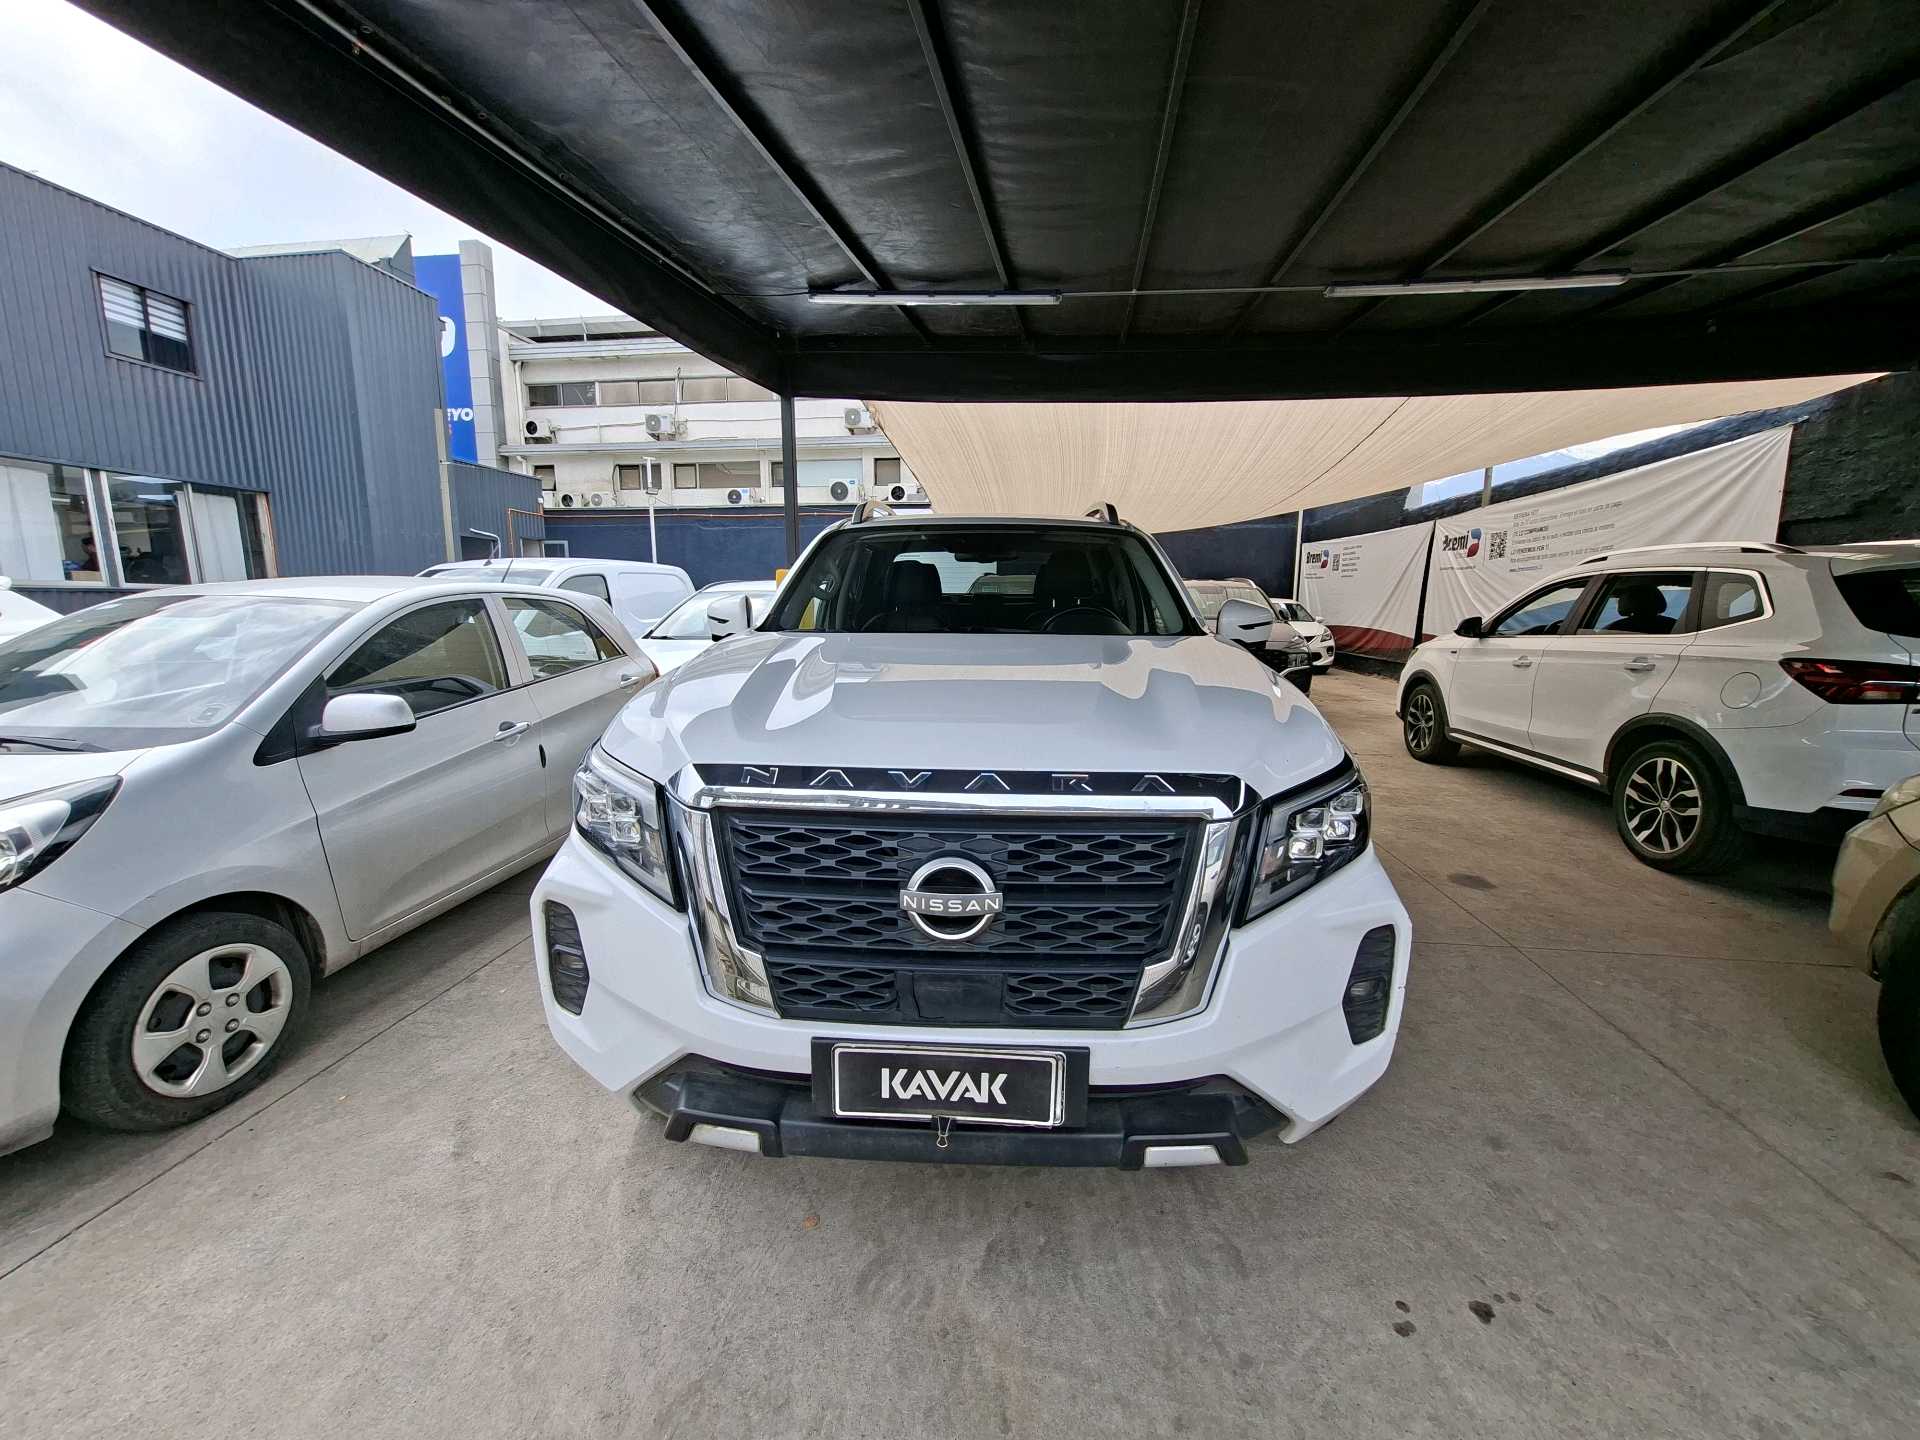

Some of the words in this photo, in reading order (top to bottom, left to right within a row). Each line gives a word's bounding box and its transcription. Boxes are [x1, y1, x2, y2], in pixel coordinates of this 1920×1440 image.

[742, 767, 1176, 792] NAVARA
[903, 894, 999, 912] NISSAN
[881, 1067, 1008, 1105] KAVAK
